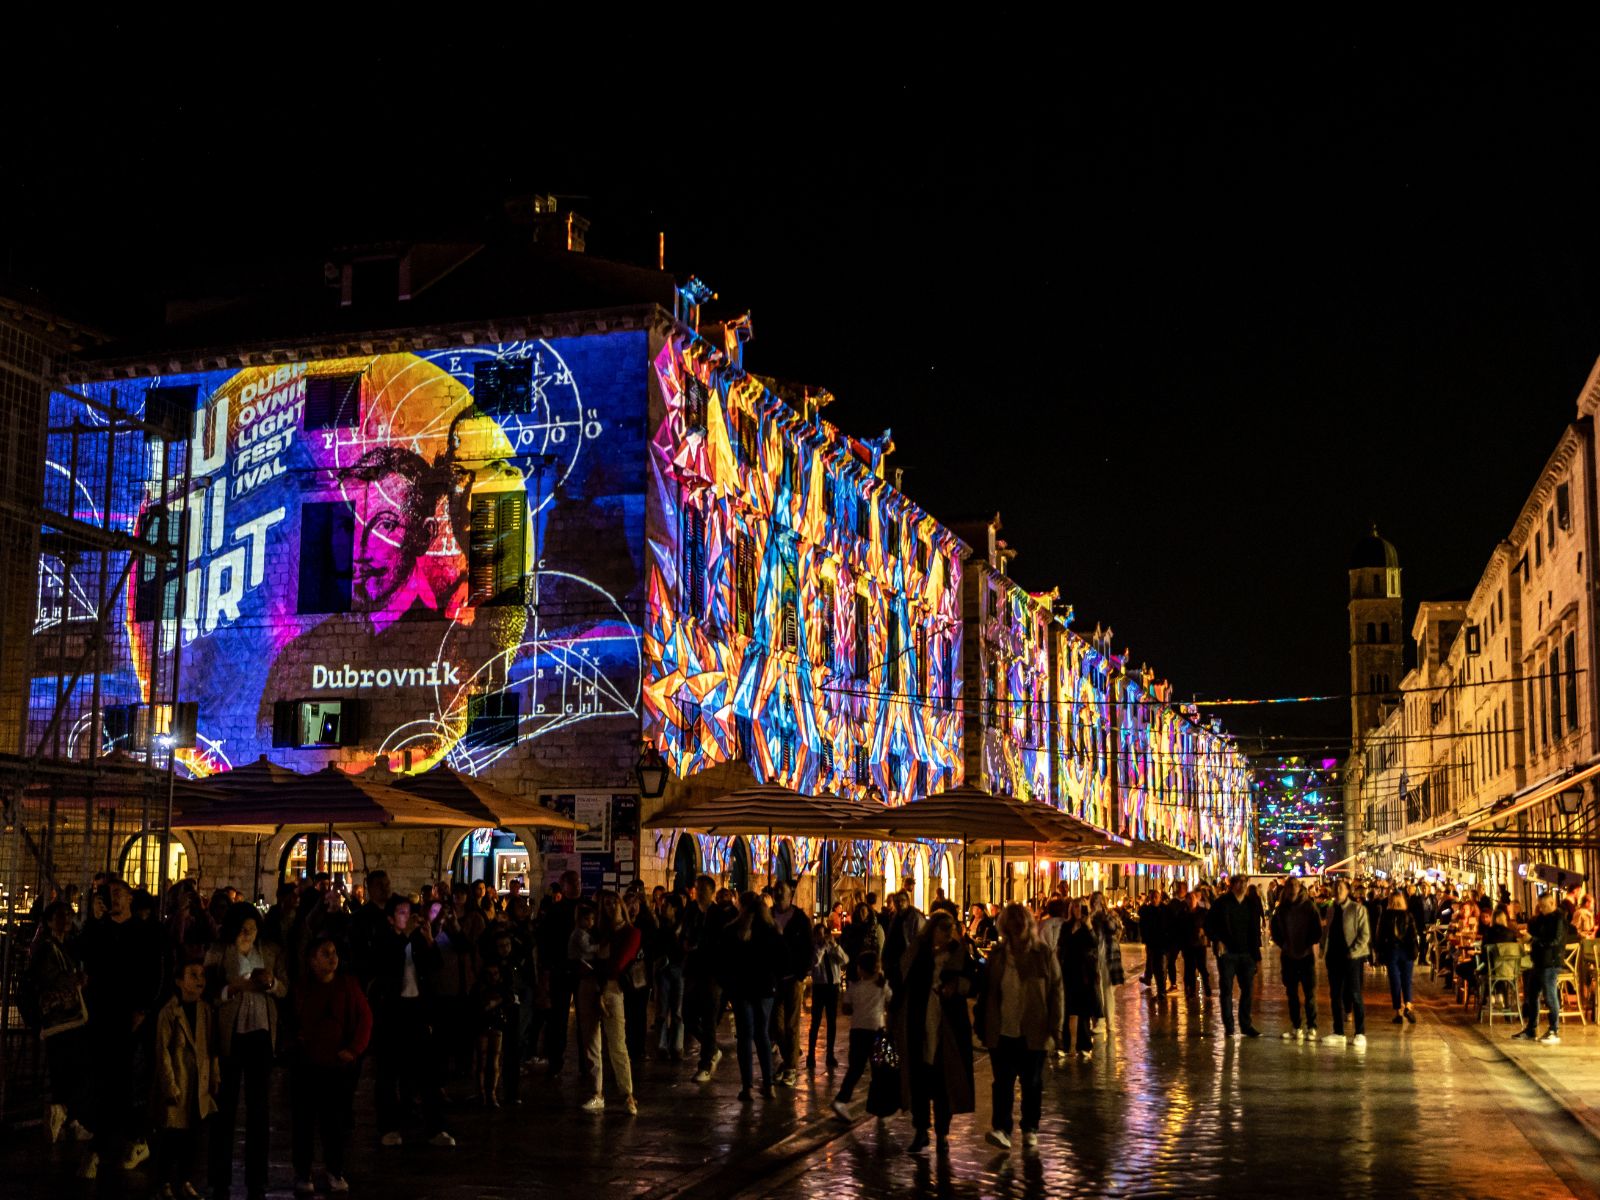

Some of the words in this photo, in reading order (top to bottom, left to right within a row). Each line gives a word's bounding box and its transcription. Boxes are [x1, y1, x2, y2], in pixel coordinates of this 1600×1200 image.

[449, 356, 462, 373] E
[238, 400, 305, 449] LIGHT
[238, 426, 297, 473] FEST
[236, 457, 287, 496] IVAL
[312, 662, 460, 689] Dubrovnik
